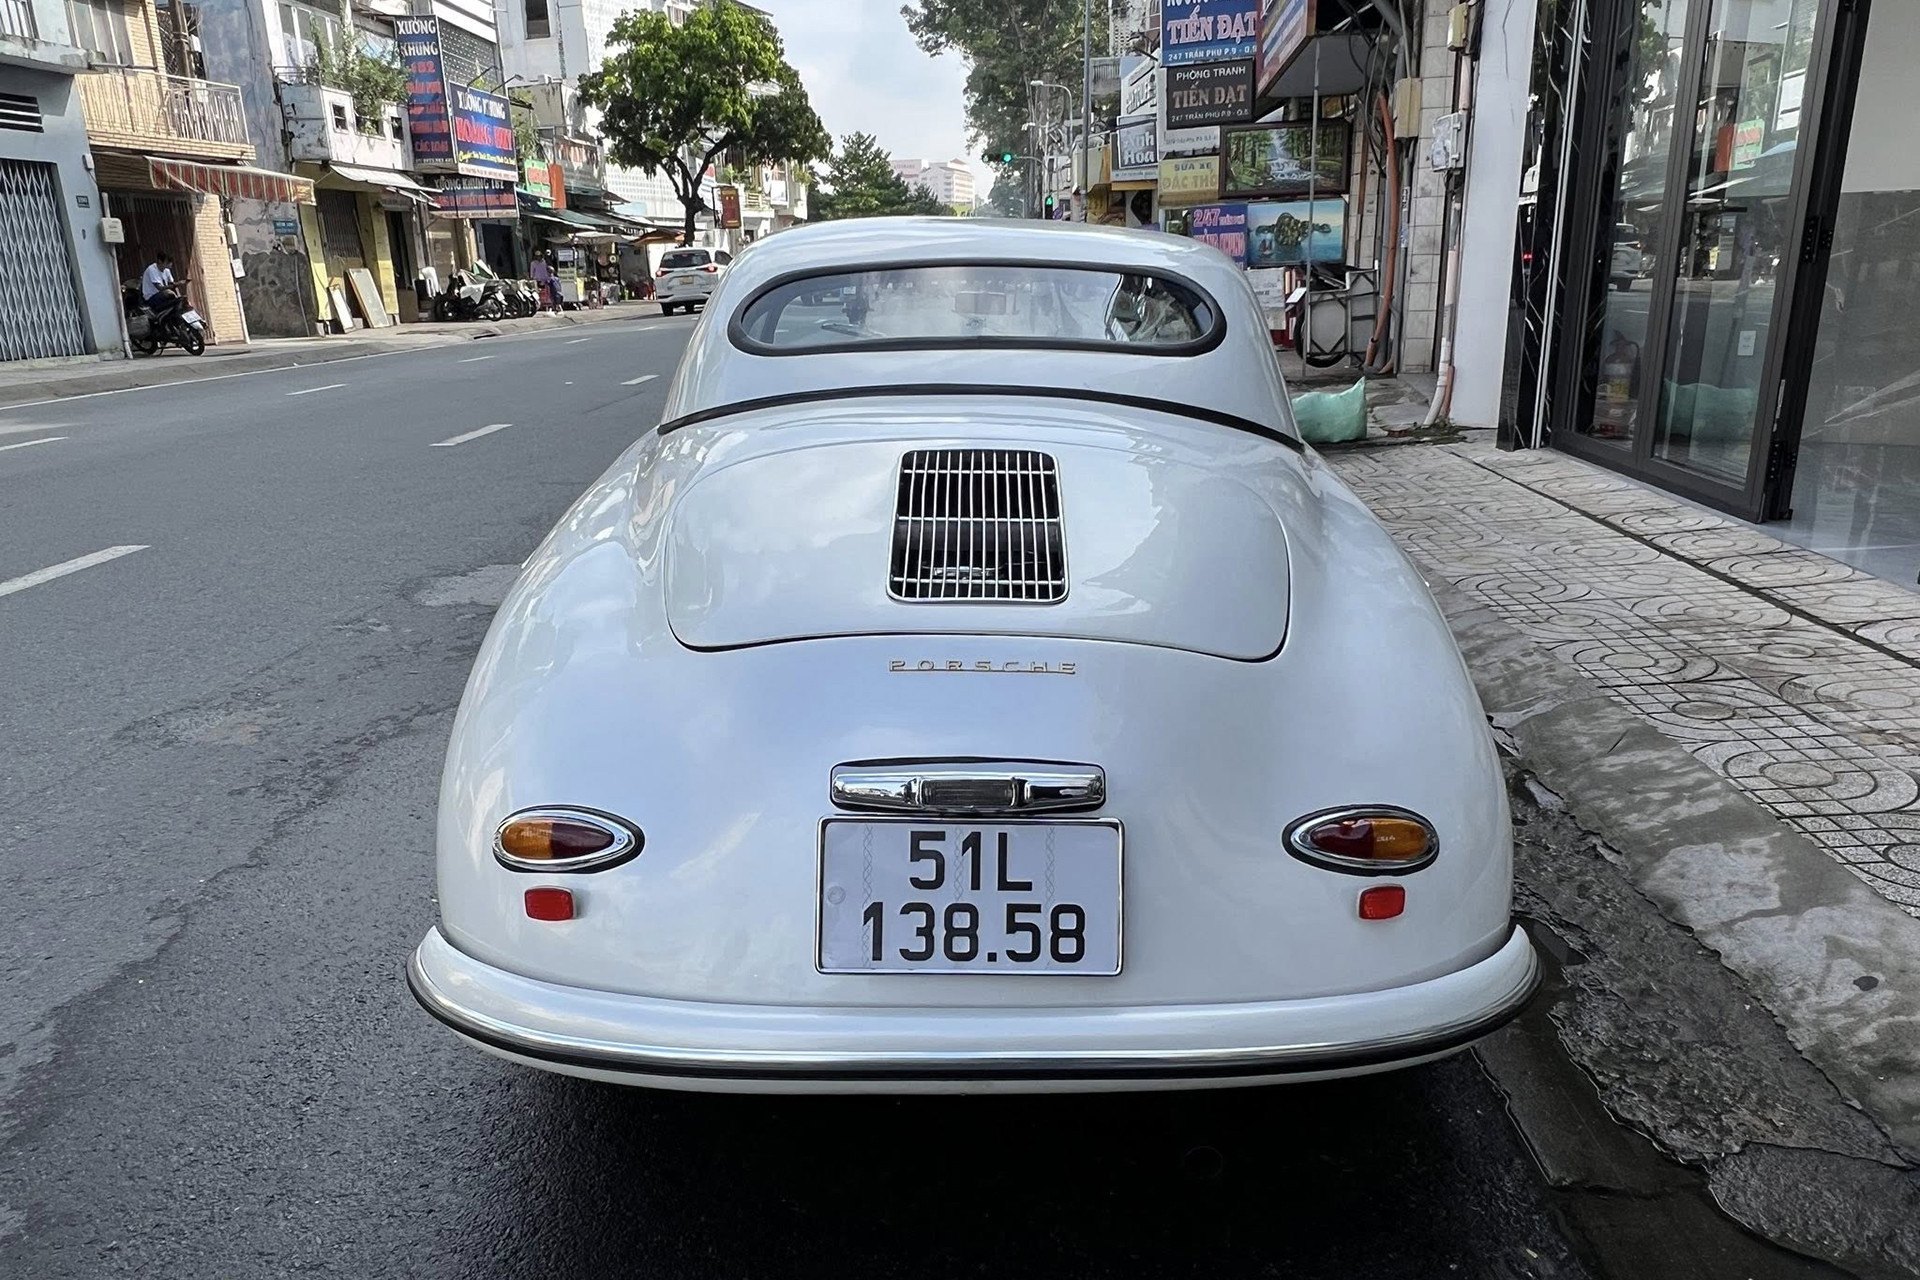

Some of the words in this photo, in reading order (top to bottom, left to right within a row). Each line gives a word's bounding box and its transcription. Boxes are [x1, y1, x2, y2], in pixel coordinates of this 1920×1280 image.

[1167, 5, 1214, 45] TIẾN
[1217, 11, 1257, 44] ĐẠT
[1168, 53, 1182, 61] 247
[1176, 67, 1210, 81] PHÒNG
[1213, 66, 1246, 77] TRANH
[1172, 80, 1209, 109] TIẾN
[1123, 151, 1155, 166] Hoa
[1193, 208, 1221, 227] 247
[889, 660, 1076, 674] PORSCHE
[909, 831, 1033, 892] 51L
[862, 901, 1086, 963] 138.58
